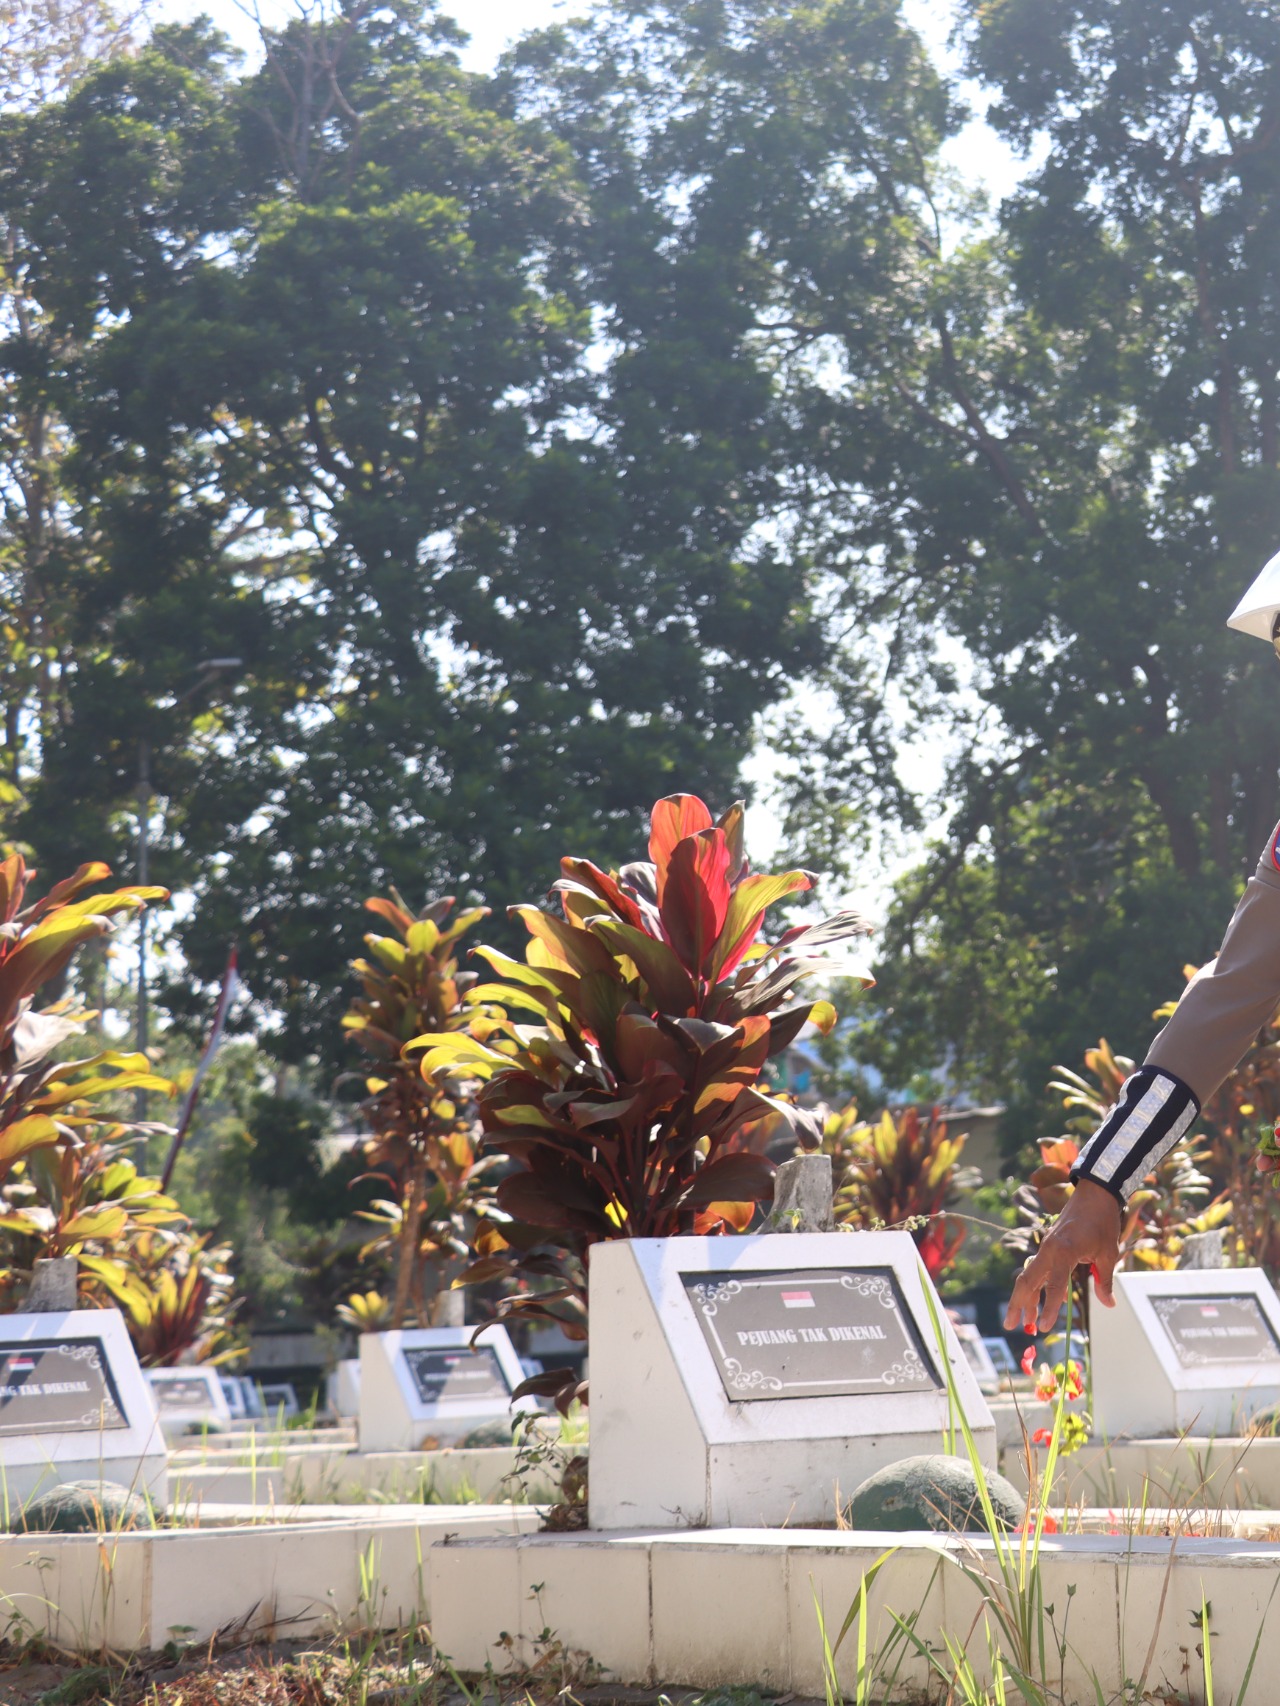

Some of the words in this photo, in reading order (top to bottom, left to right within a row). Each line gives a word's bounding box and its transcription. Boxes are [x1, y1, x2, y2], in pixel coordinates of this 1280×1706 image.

[737, 1328, 798, 1346] PEJUANG
[798, 1327, 828, 1342] TAK
[828, 1325, 887, 1341] DIKENAL
